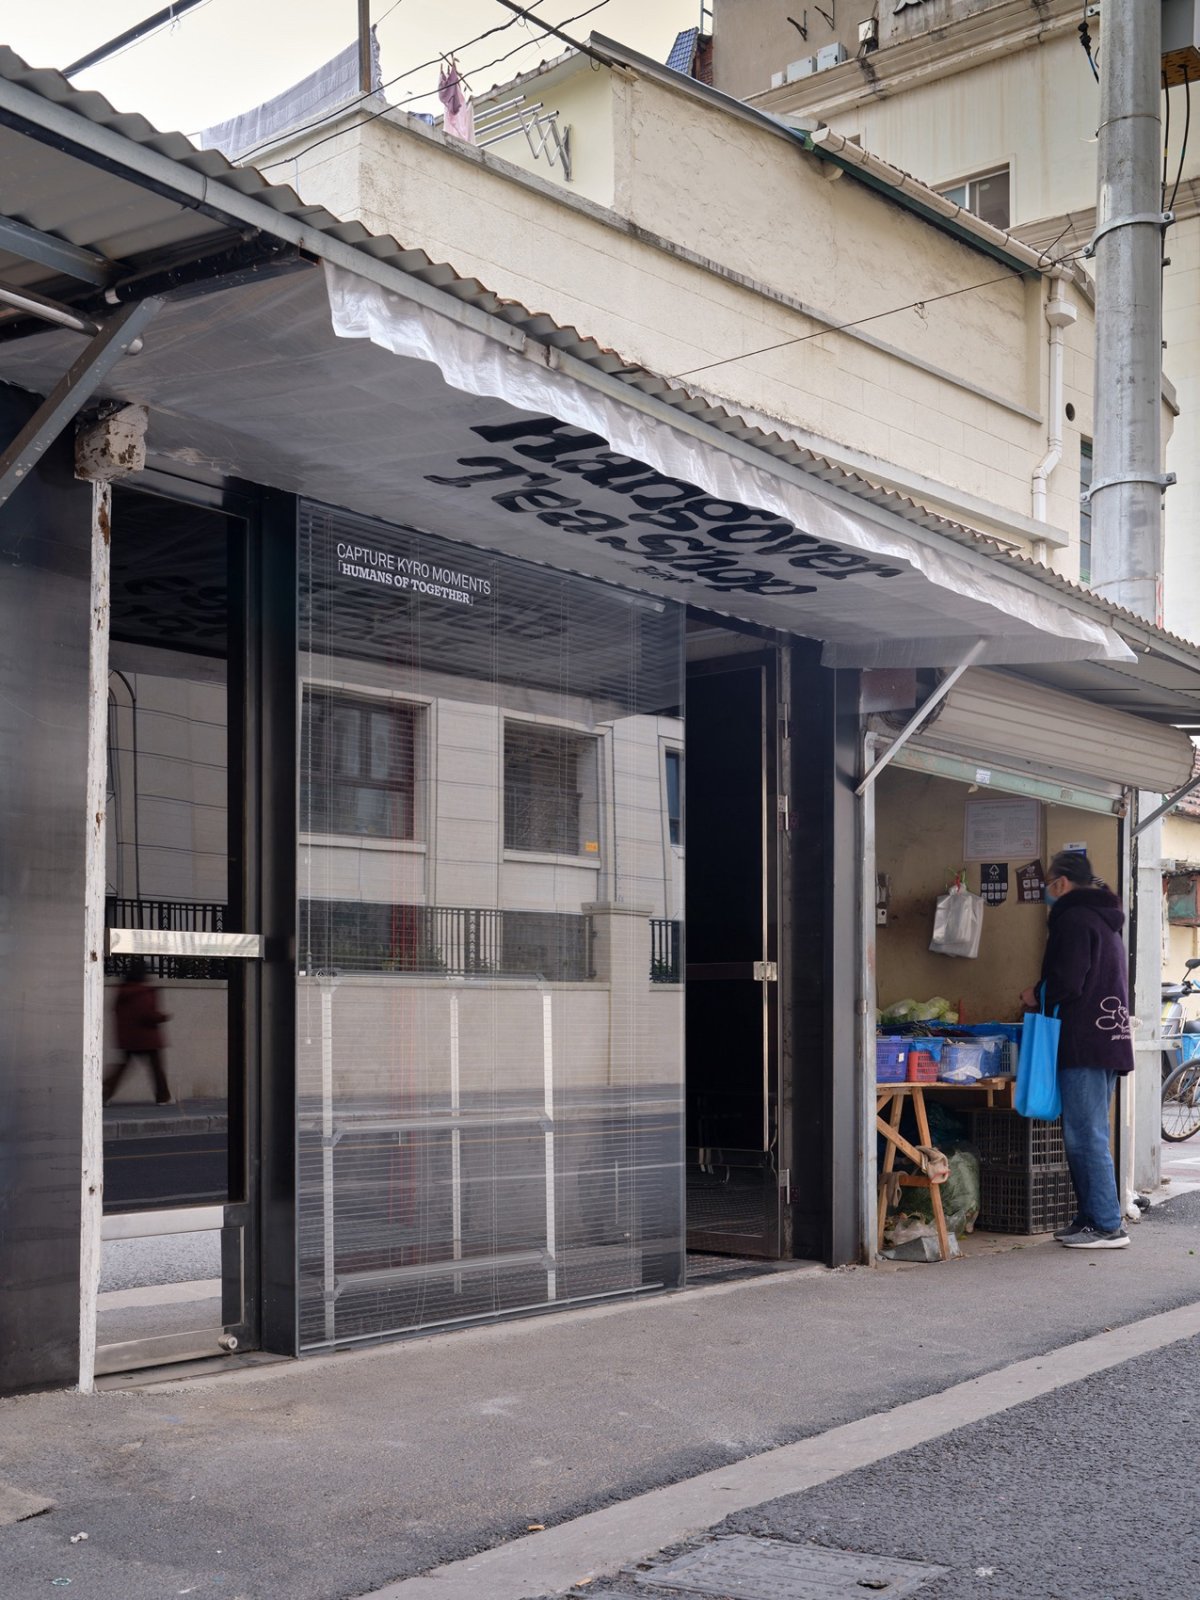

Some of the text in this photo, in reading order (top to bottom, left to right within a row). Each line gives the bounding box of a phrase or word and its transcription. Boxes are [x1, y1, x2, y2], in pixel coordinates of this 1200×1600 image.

[423, 456, 818, 596] Tea Shop
[470, 417, 904, 580] Hangover
[337, 543, 491, 595] CAPTURE KYRO MOMENTS
[394, 574, 410, 589] OF
